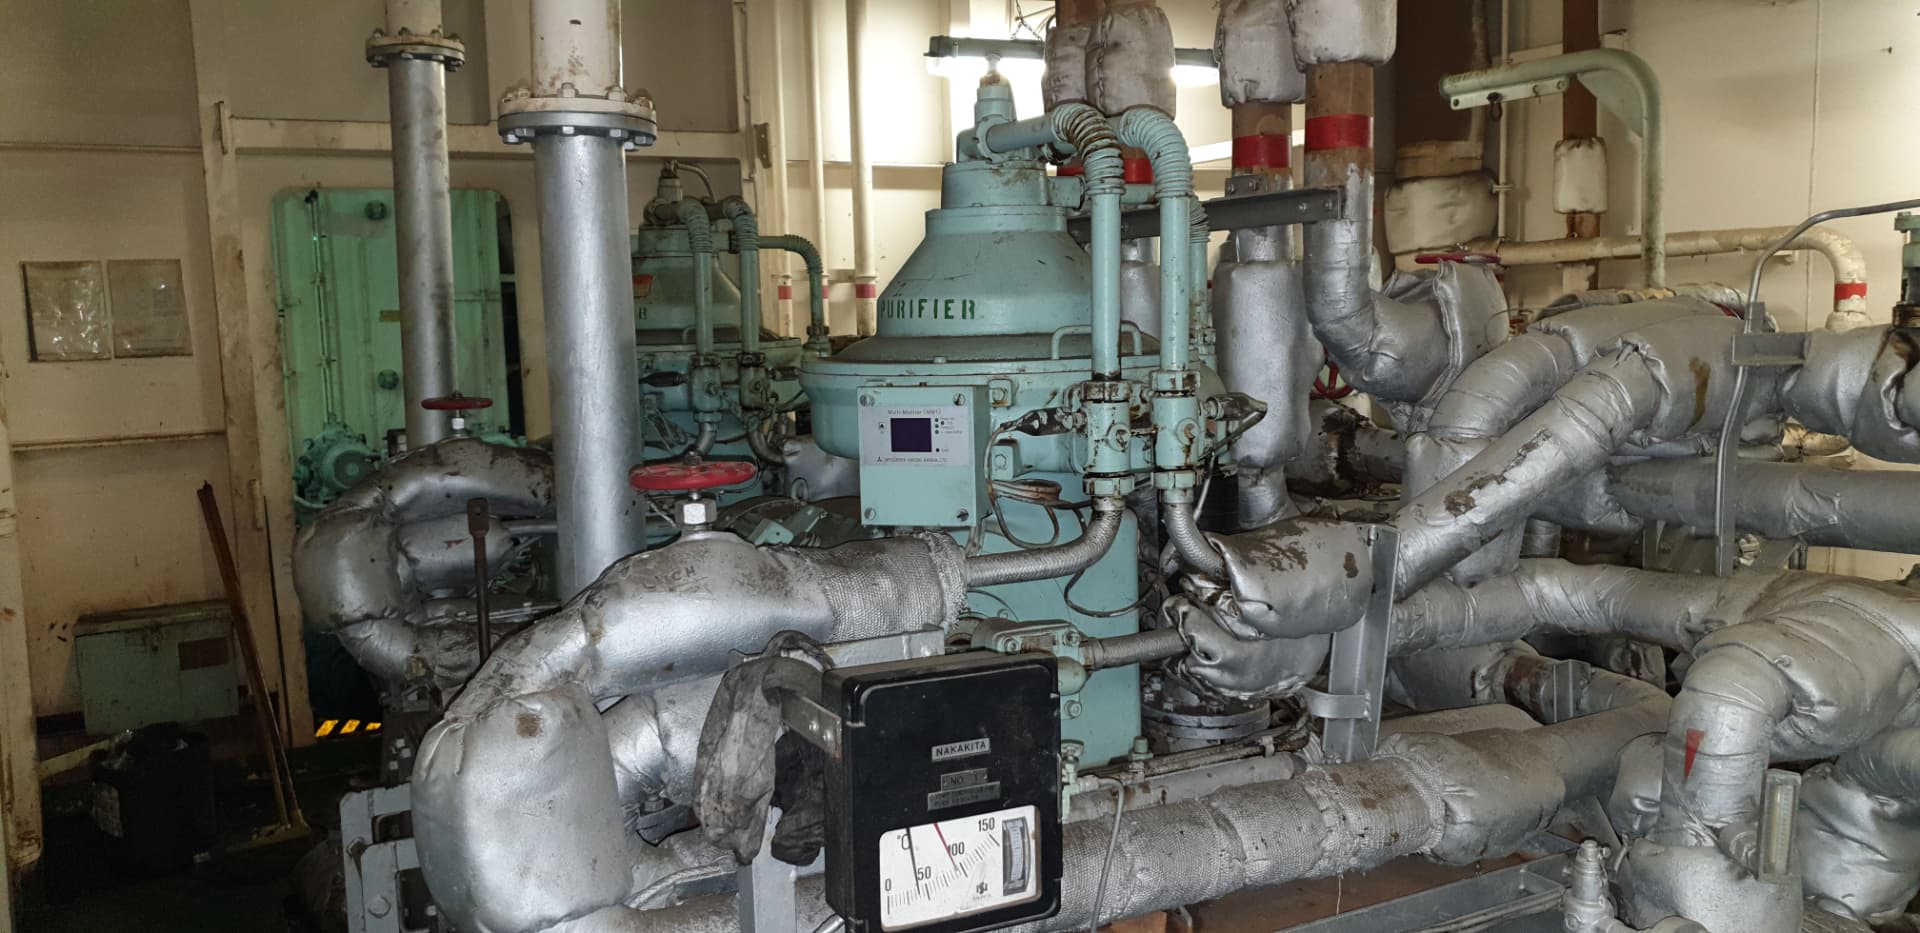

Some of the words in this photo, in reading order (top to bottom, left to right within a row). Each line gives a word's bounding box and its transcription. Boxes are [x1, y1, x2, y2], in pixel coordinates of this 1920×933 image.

[880, 298, 975, 320] PURIFIER
[935, 740, 986, 757] NAKAKITA
[978, 817, 995, 832] 150
[947, 841, 965, 857] 100
[917, 866, 932, 881] 50
[885, 878, 892, 892] 0
